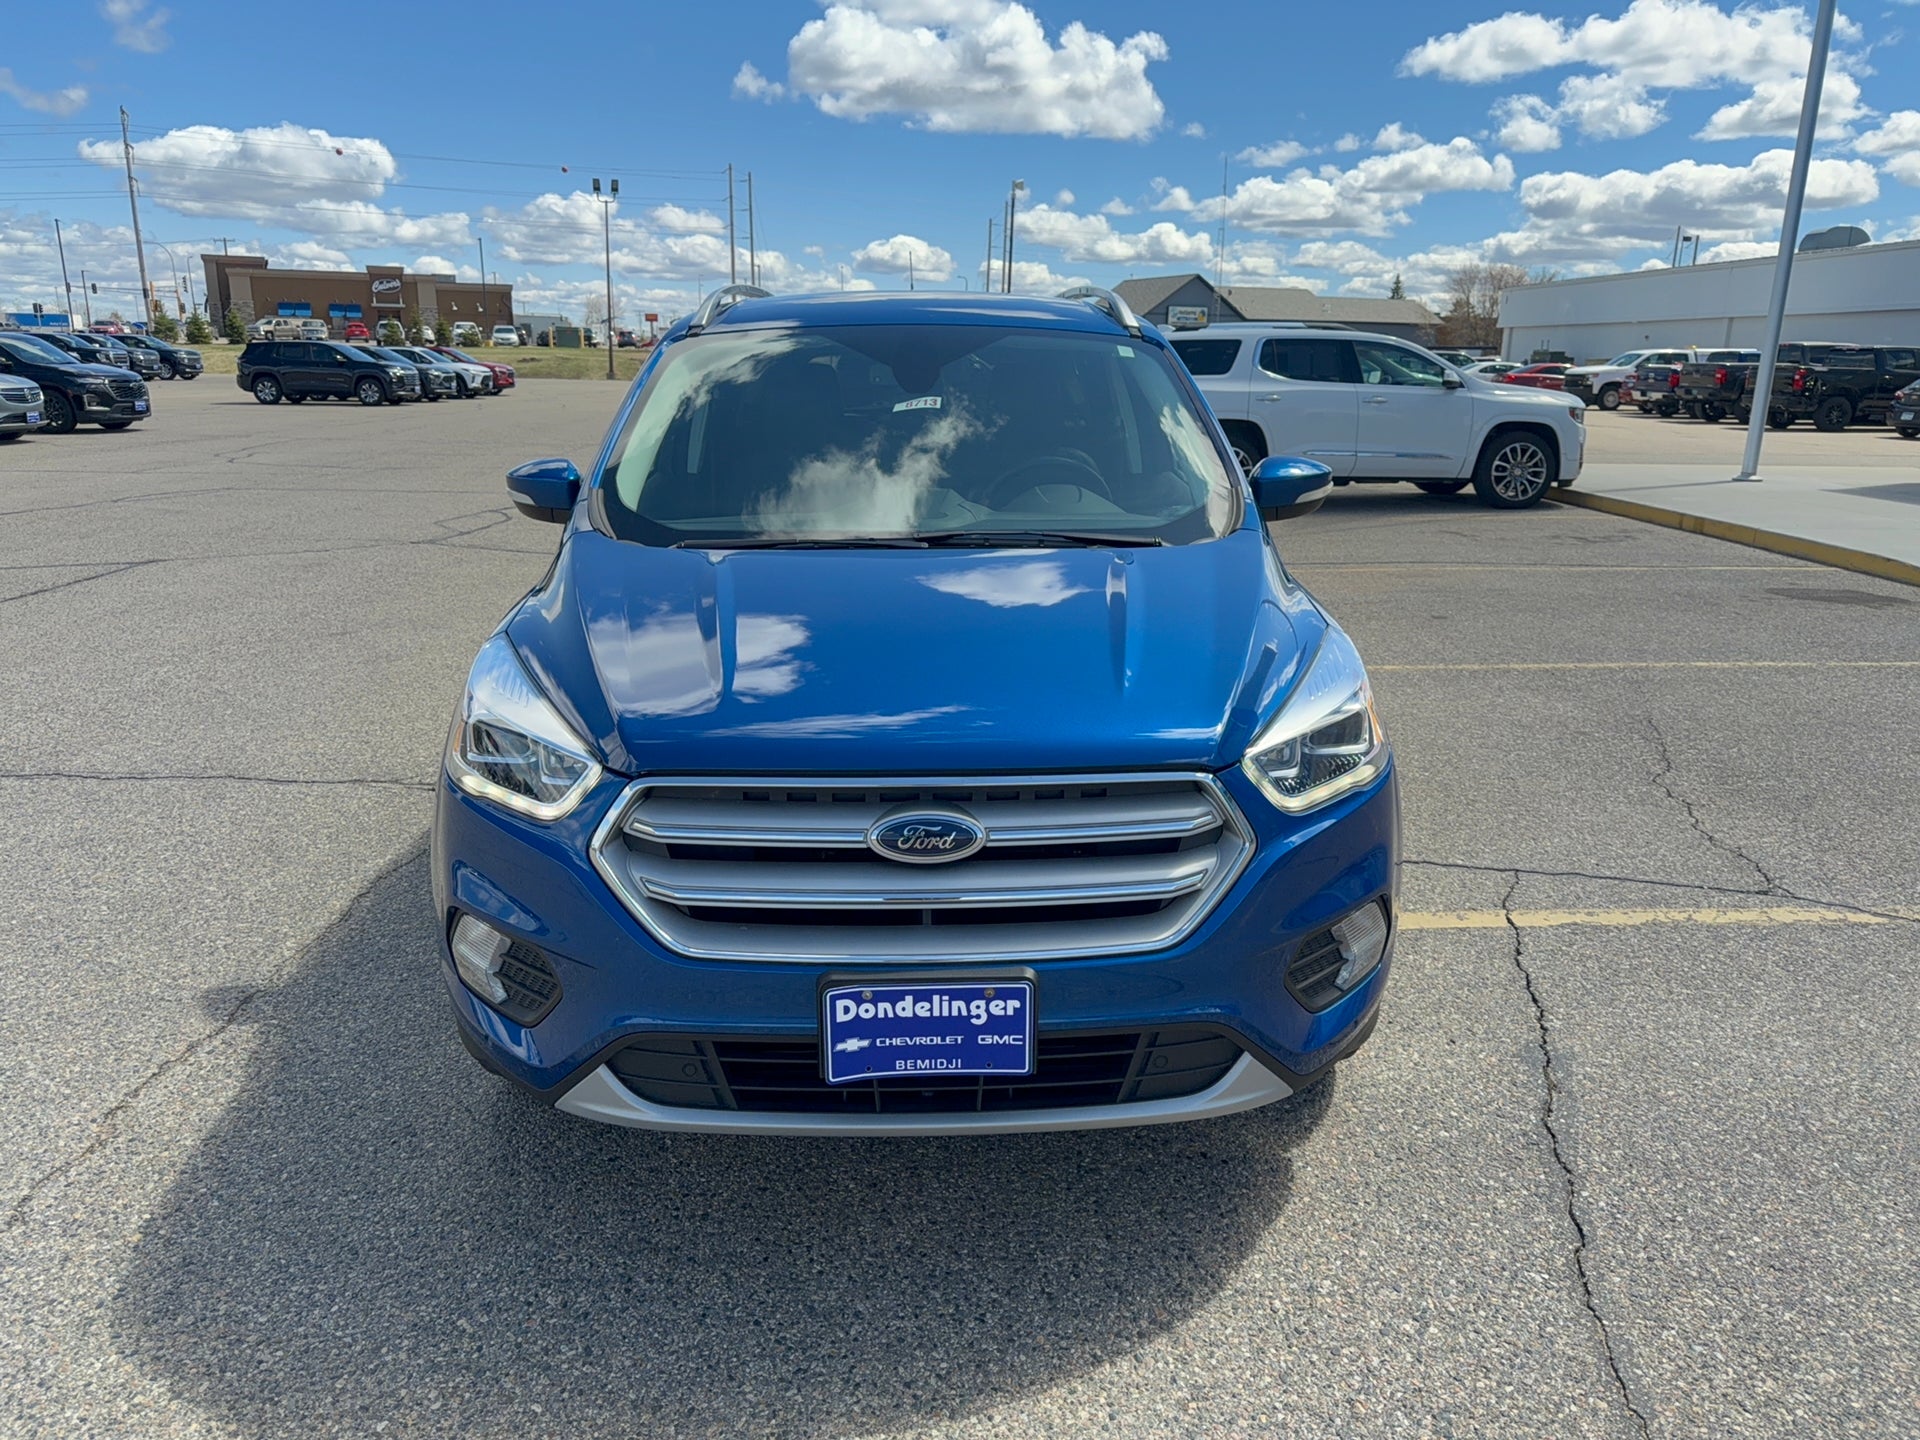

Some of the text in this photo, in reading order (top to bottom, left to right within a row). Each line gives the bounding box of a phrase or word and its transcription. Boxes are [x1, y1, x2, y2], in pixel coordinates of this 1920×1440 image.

[897, 824, 957, 850] Ford
[835, 994, 1022, 1026] Dondelinger
[876, 1034, 1024, 1047] CHEVROLET GMC
[895, 1058, 962, 1070] BEMIDJI
